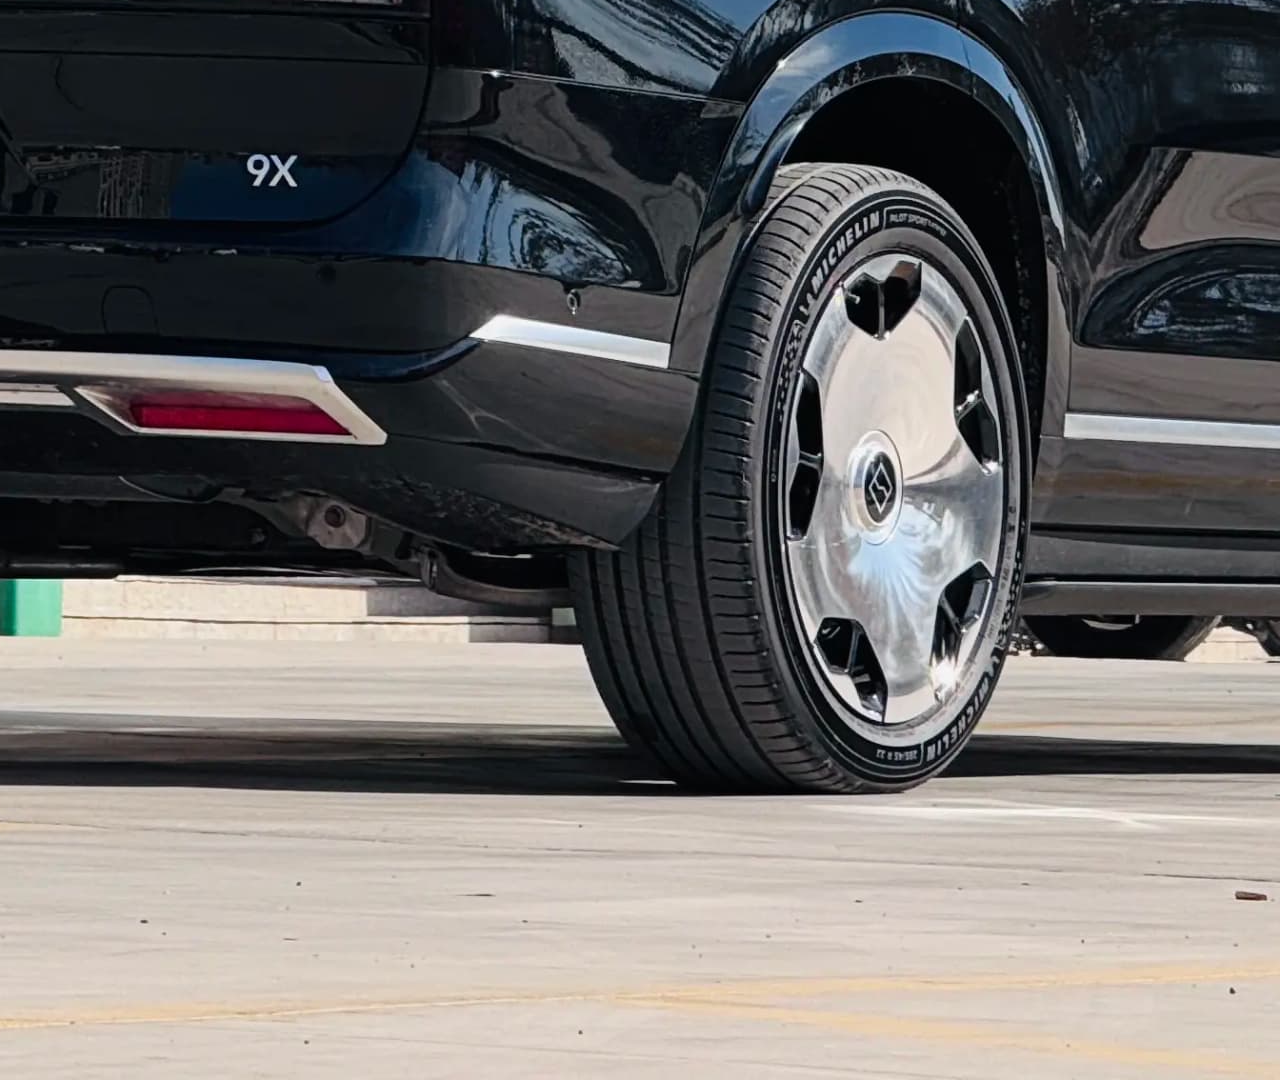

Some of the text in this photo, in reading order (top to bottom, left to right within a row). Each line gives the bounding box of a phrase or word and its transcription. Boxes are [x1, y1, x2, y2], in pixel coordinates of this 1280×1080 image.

[246, 153, 298, 188] 9X
[811, 211, 880, 293] MICHELIN
[926, 677, 990, 761] MICHELIN
